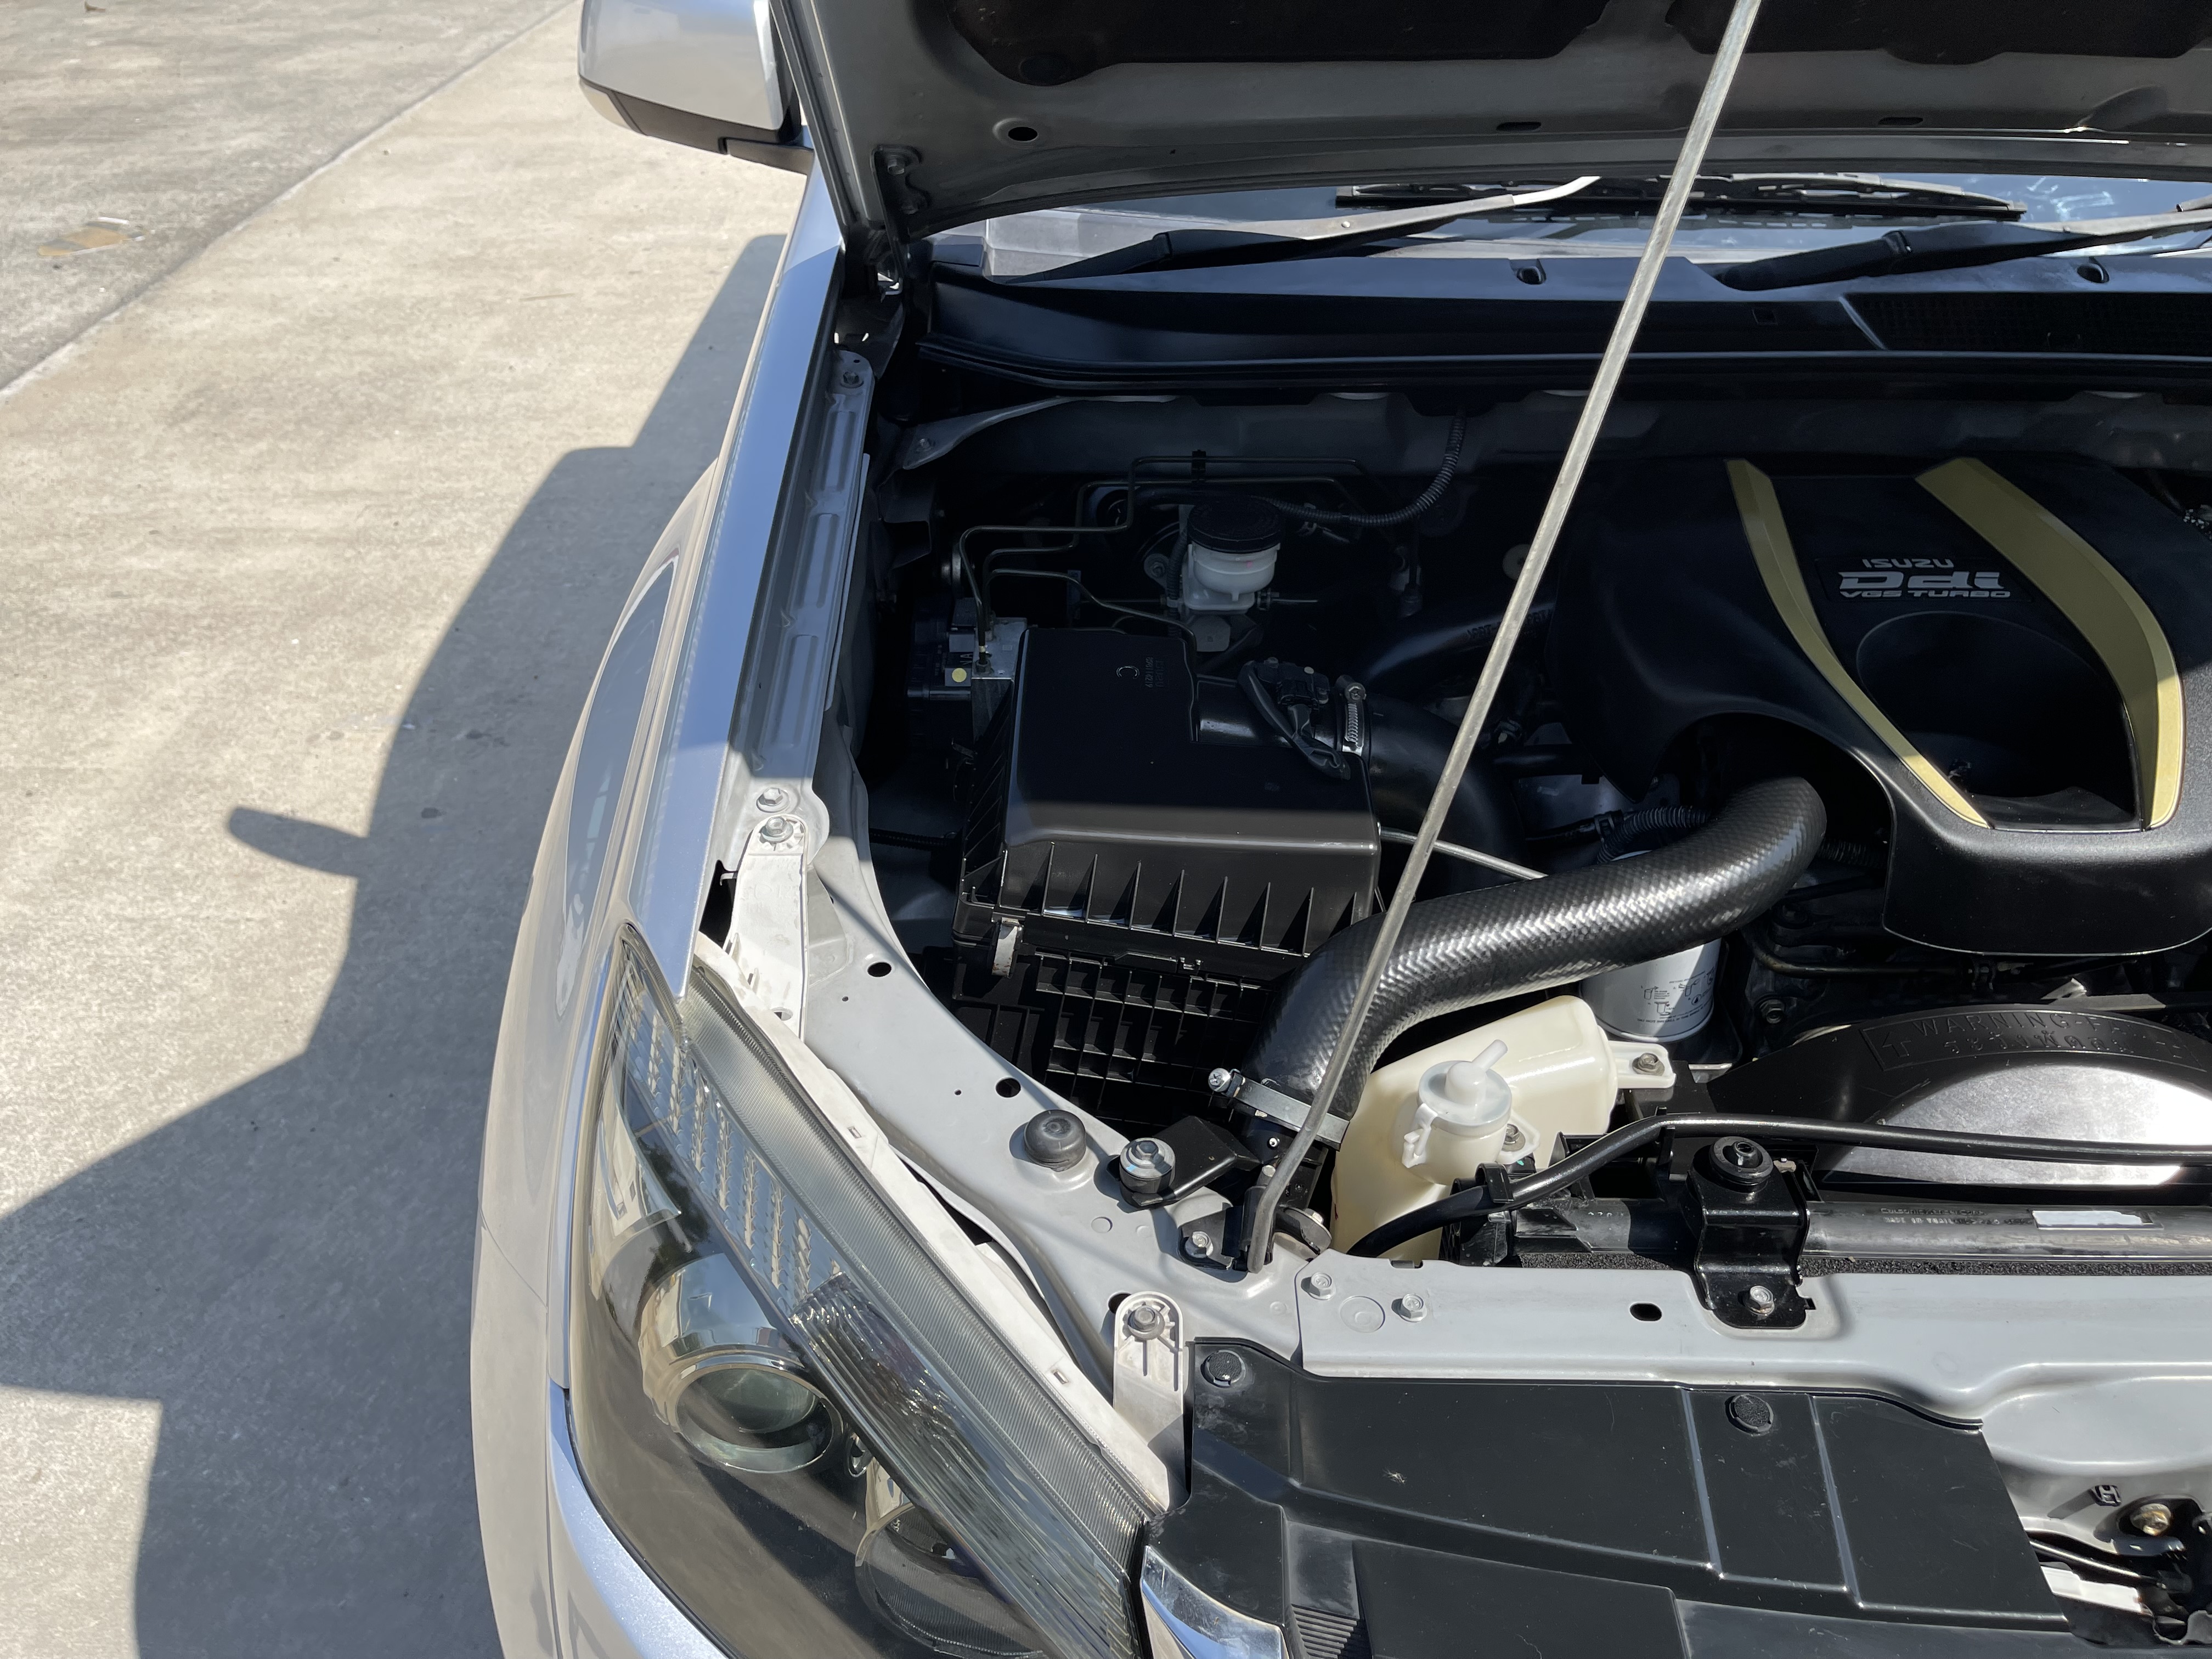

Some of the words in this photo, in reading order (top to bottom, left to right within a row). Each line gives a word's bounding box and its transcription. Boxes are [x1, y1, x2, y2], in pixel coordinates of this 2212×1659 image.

[1861, 558, 1955, 568] ISUZU
[1839, 590, 1903, 599] VGS
[1907, 590, 2011, 599] TURBO
